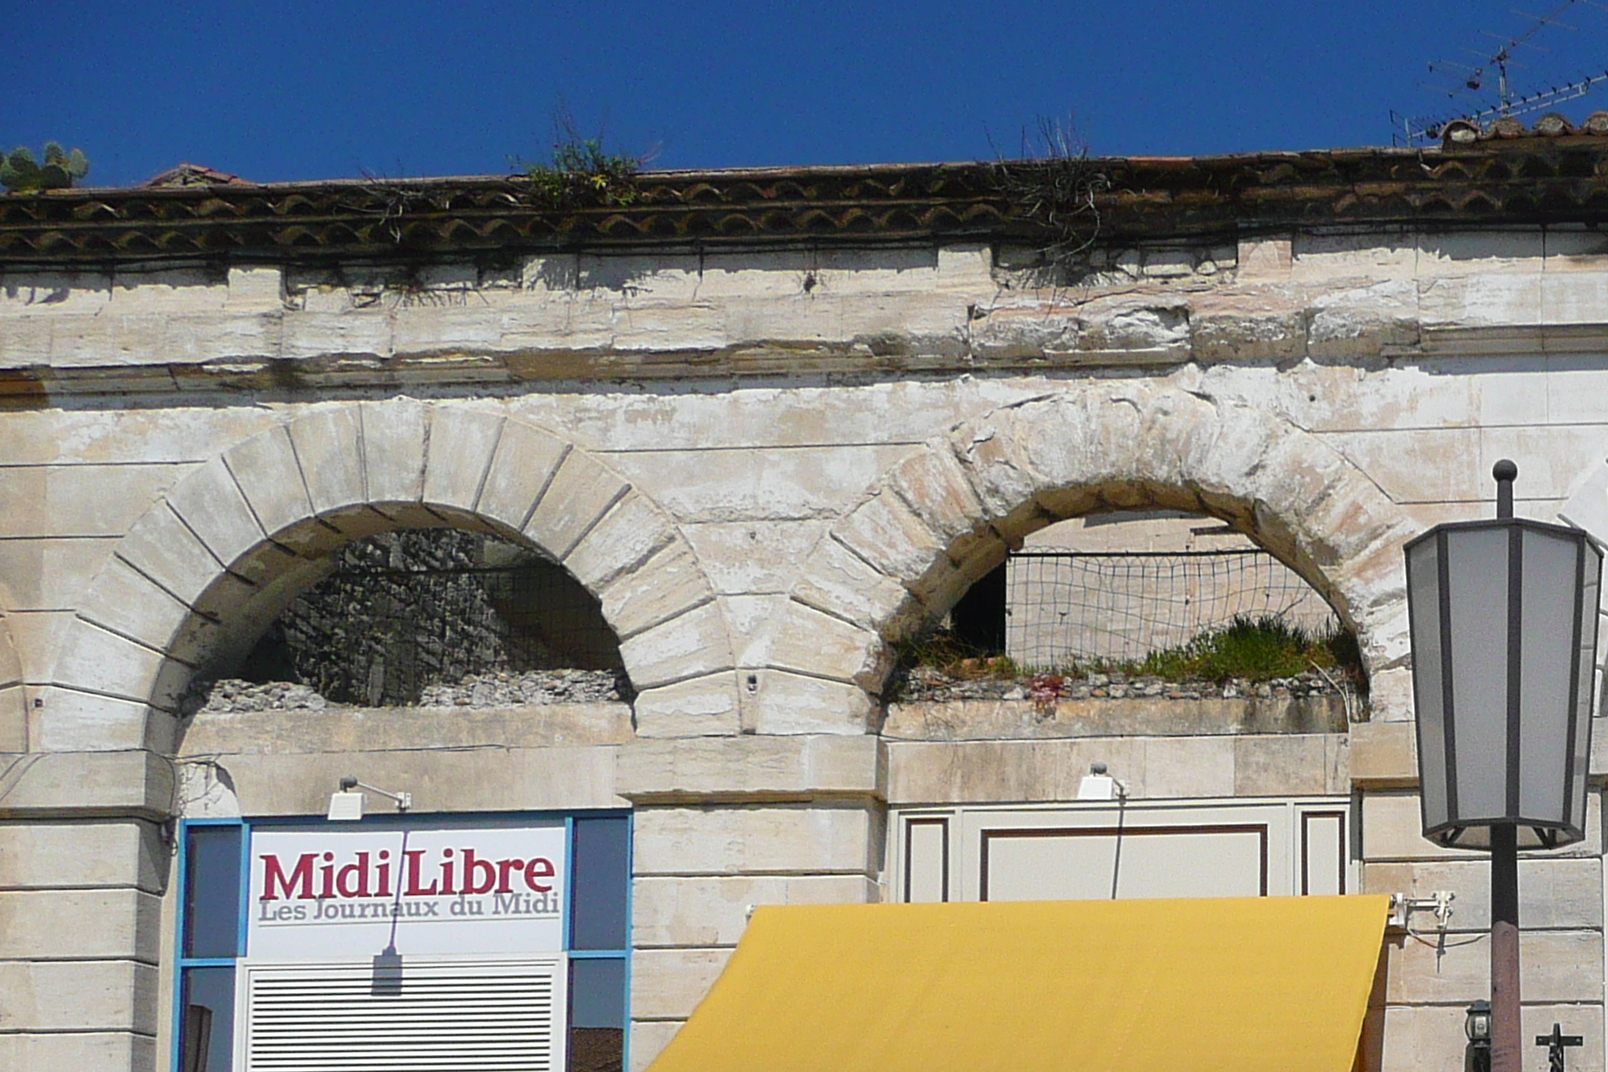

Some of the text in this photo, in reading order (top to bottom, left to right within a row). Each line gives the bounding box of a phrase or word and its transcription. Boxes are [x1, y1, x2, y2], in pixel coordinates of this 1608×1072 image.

[258, 848, 555, 900] Midi Libre
[258, 892, 560, 922] Les Journaux du Midi
